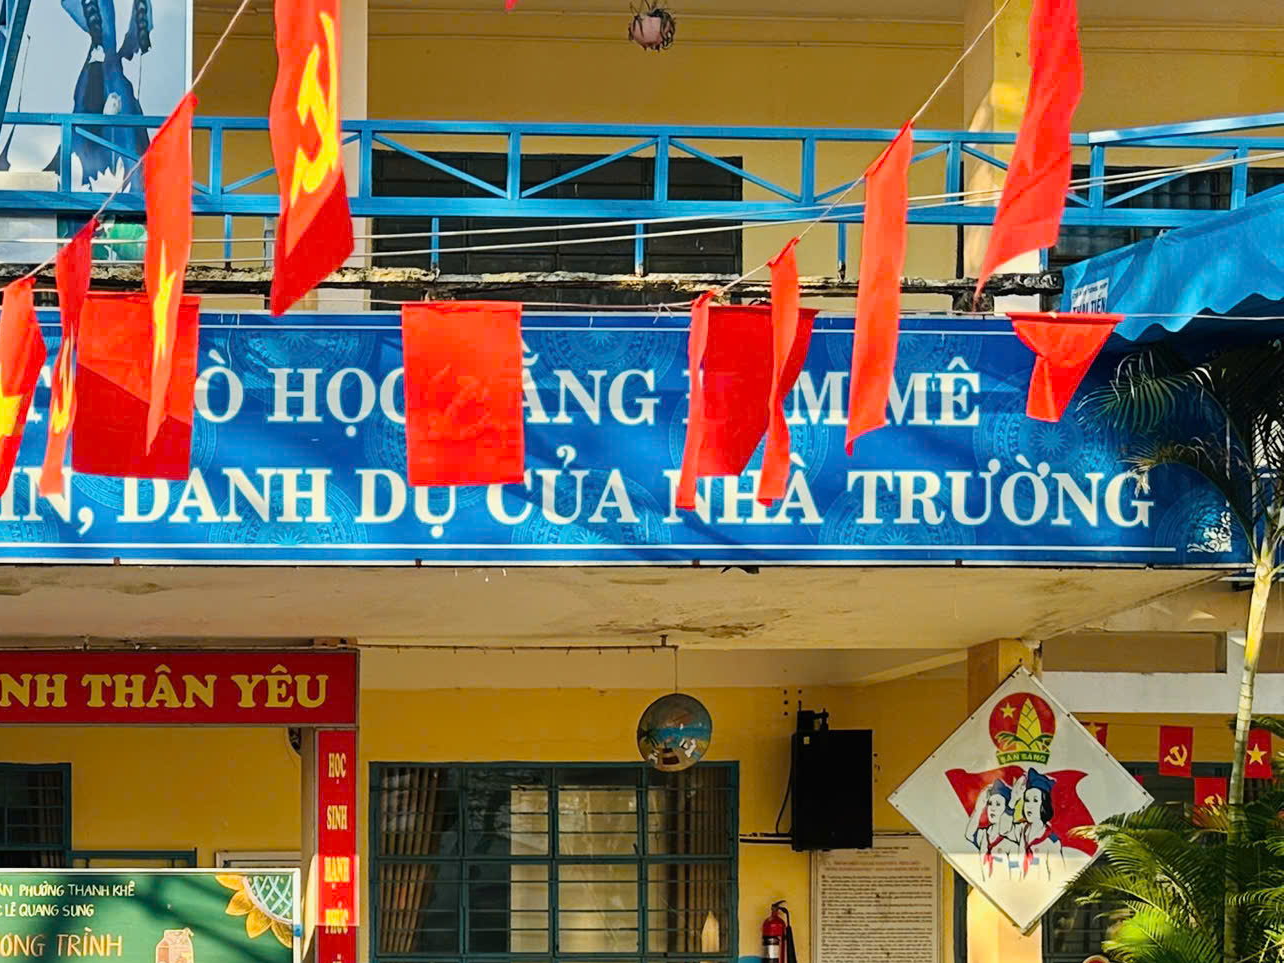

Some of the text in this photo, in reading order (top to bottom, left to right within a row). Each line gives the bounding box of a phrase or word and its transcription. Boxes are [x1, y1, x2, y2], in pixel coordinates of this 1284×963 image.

[117, 466, 332, 524] DANH
[486, 445, 641, 525] CỦA
[662, 451, 824, 524] NHÀ
[847, 454, 1154, 528] TRƯỜNG
[81, 664, 217, 708] THÂN
[230, 663, 329, 708] YÊU
[328, 752, 347, 785] HỌC
[326, 804, 348, 830] SINH
[19, 880, 65, 897] PHƯỜNG
[68, 883, 109, 897] THANH
[112, 880, 135, 897] KHÊ
[324, 856, 350, 889] HẠNH
[5, 901, 16, 918] LÊ
[19, 903, 59, 917] QUANG
[62, 904, 95, 918] SUNG
[325, 901, 349, 935] PHÚC
[57, 926, 123, 958] TRÌNH
